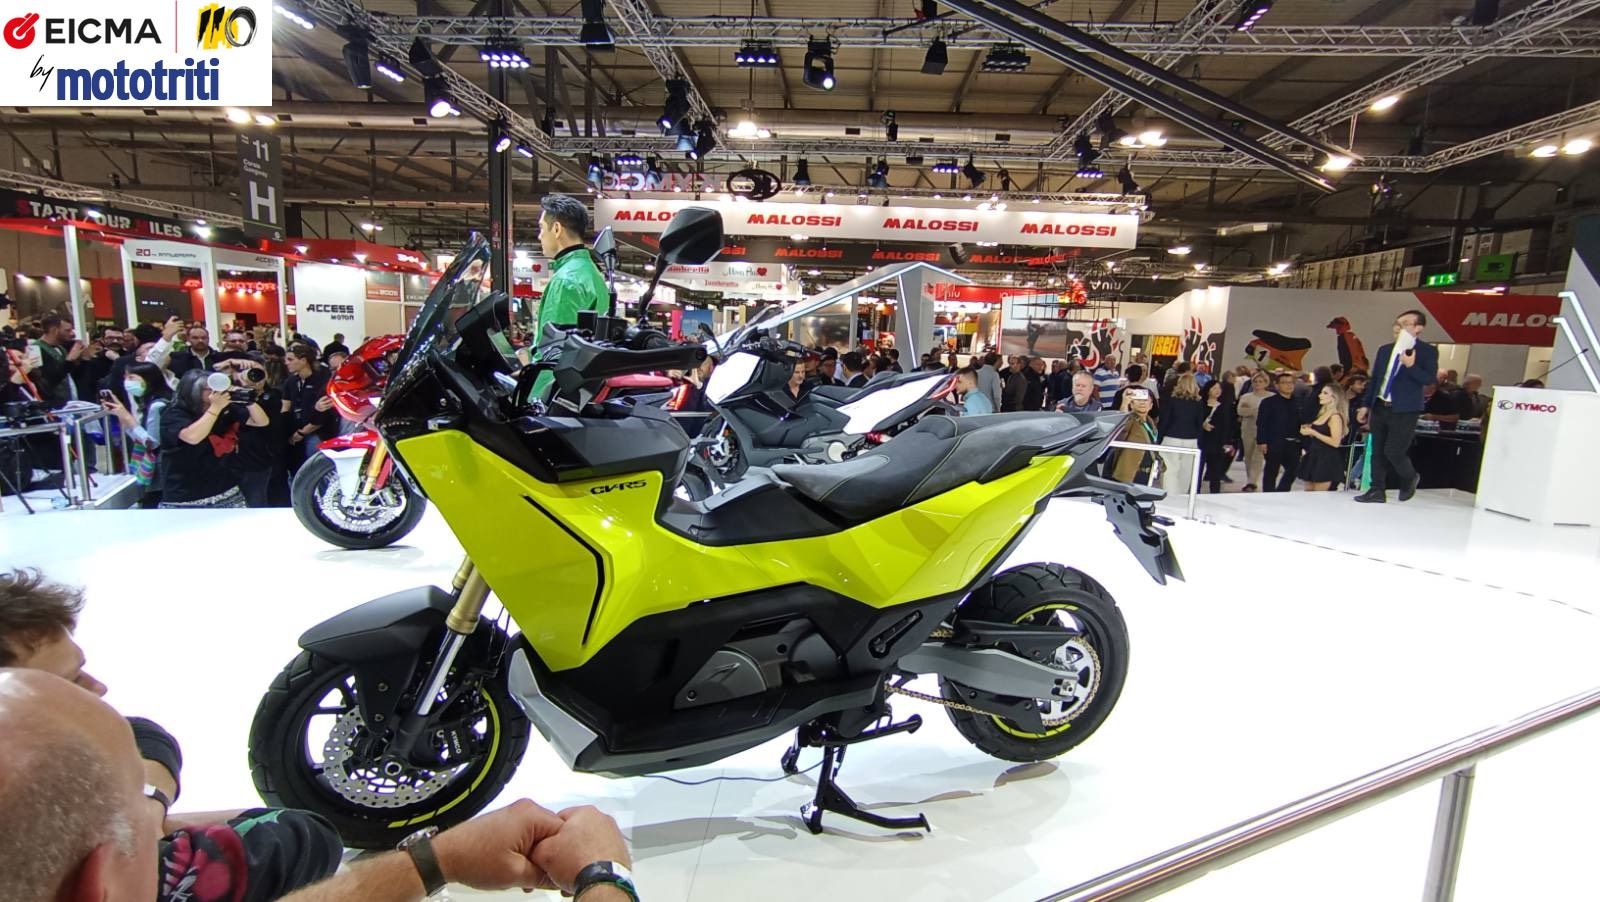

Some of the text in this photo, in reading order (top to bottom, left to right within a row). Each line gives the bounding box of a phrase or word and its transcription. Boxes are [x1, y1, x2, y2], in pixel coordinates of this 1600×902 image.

[252, 139, 270, 162] 11
[249, 180, 277, 225] H
[614, 210, 677, 222] MALO
[747, 213, 842, 227] MALOSSI
[883, 217, 979, 232] MALOSSI
[1020, 222, 1117, 237] MALOSSI
[135, 248, 151, 257] 20
[775, 248, 843, 259] MALOSSI
[872, 251, 940, 262] MALOSSI
[306, 303, 354, 314] ACCESS
[1514, 402, 1557, 413] KYMCO
[450, 730, 462, 754] KYMCO
